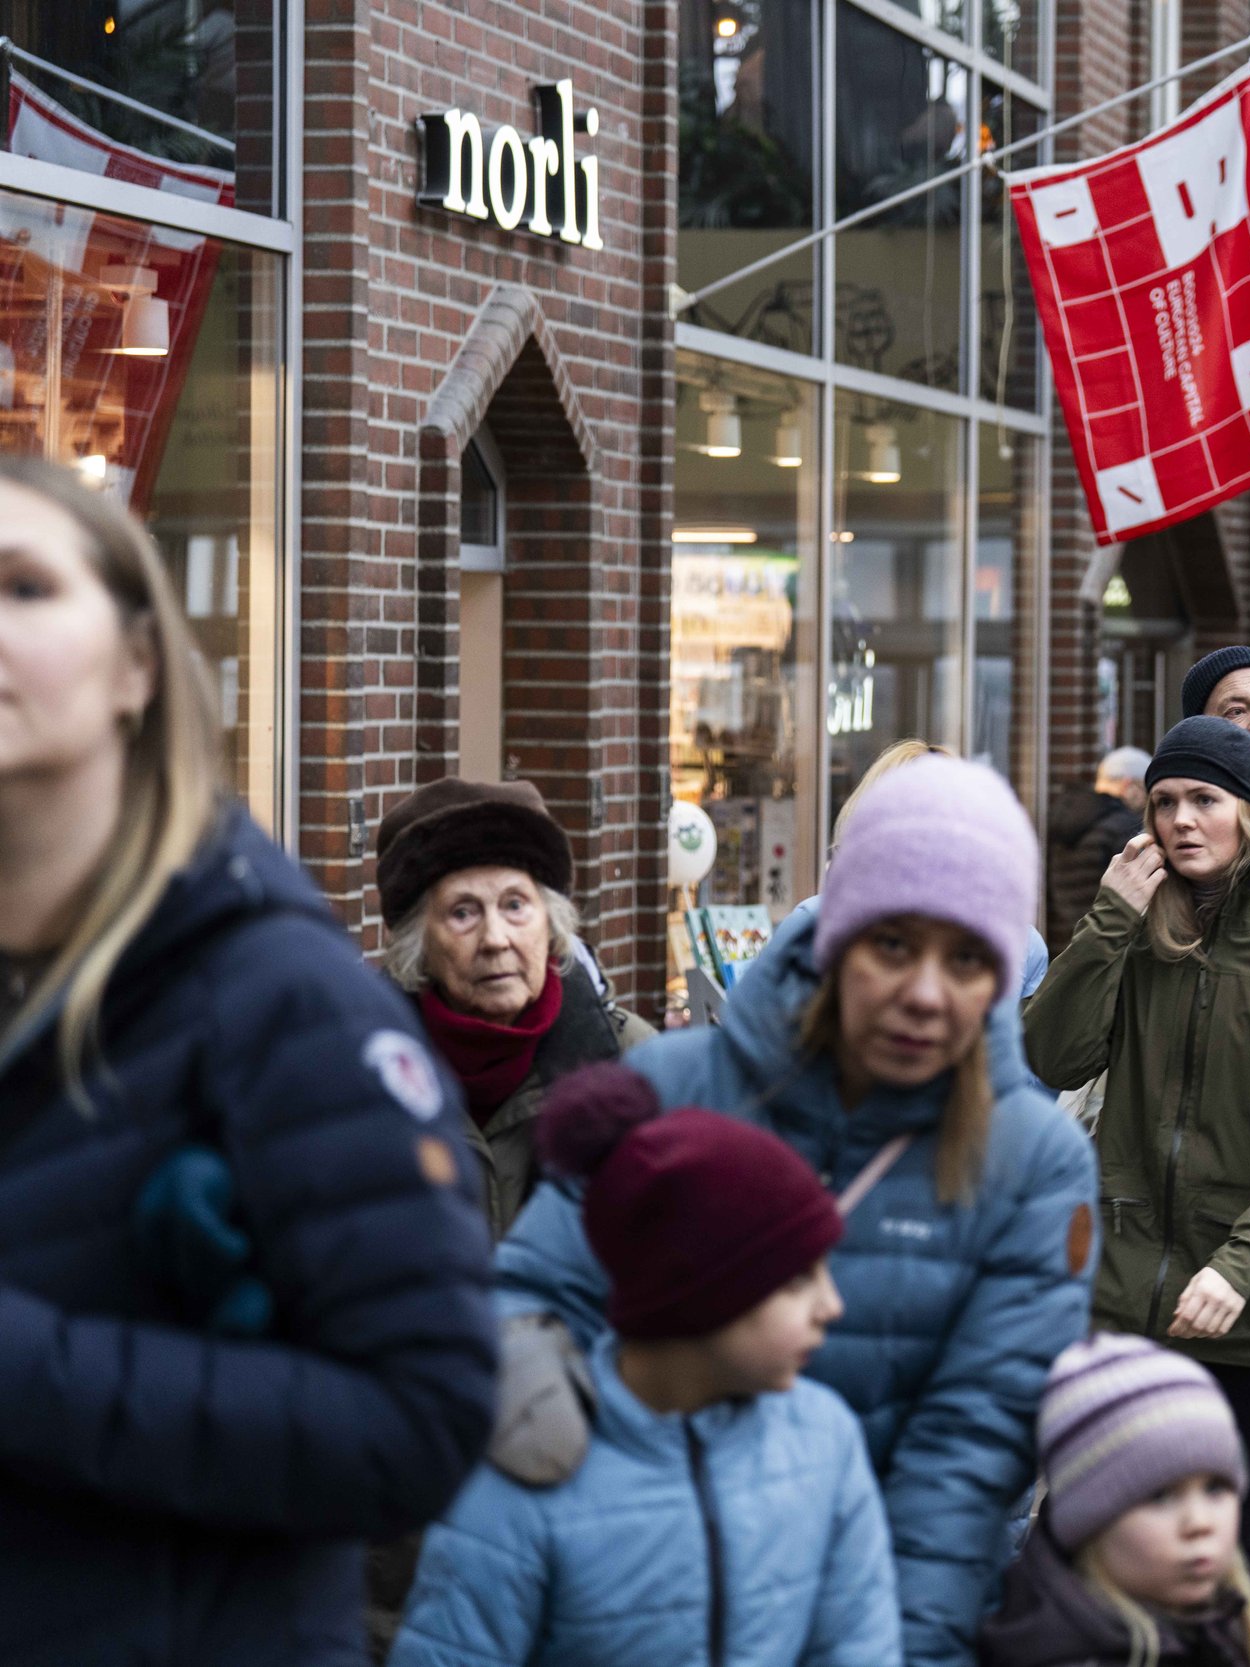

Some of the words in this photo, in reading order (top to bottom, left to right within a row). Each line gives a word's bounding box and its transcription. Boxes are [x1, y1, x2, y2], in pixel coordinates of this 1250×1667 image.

[442, 78, 604, 251] norli
[1149, 287, 1168, 312] OF
[1166, 279, 1189, 363] EUROPEAN
[1155, 310, 1177, 382] CULTURE
[1177, 360, 1205, 429] CAPITAL
